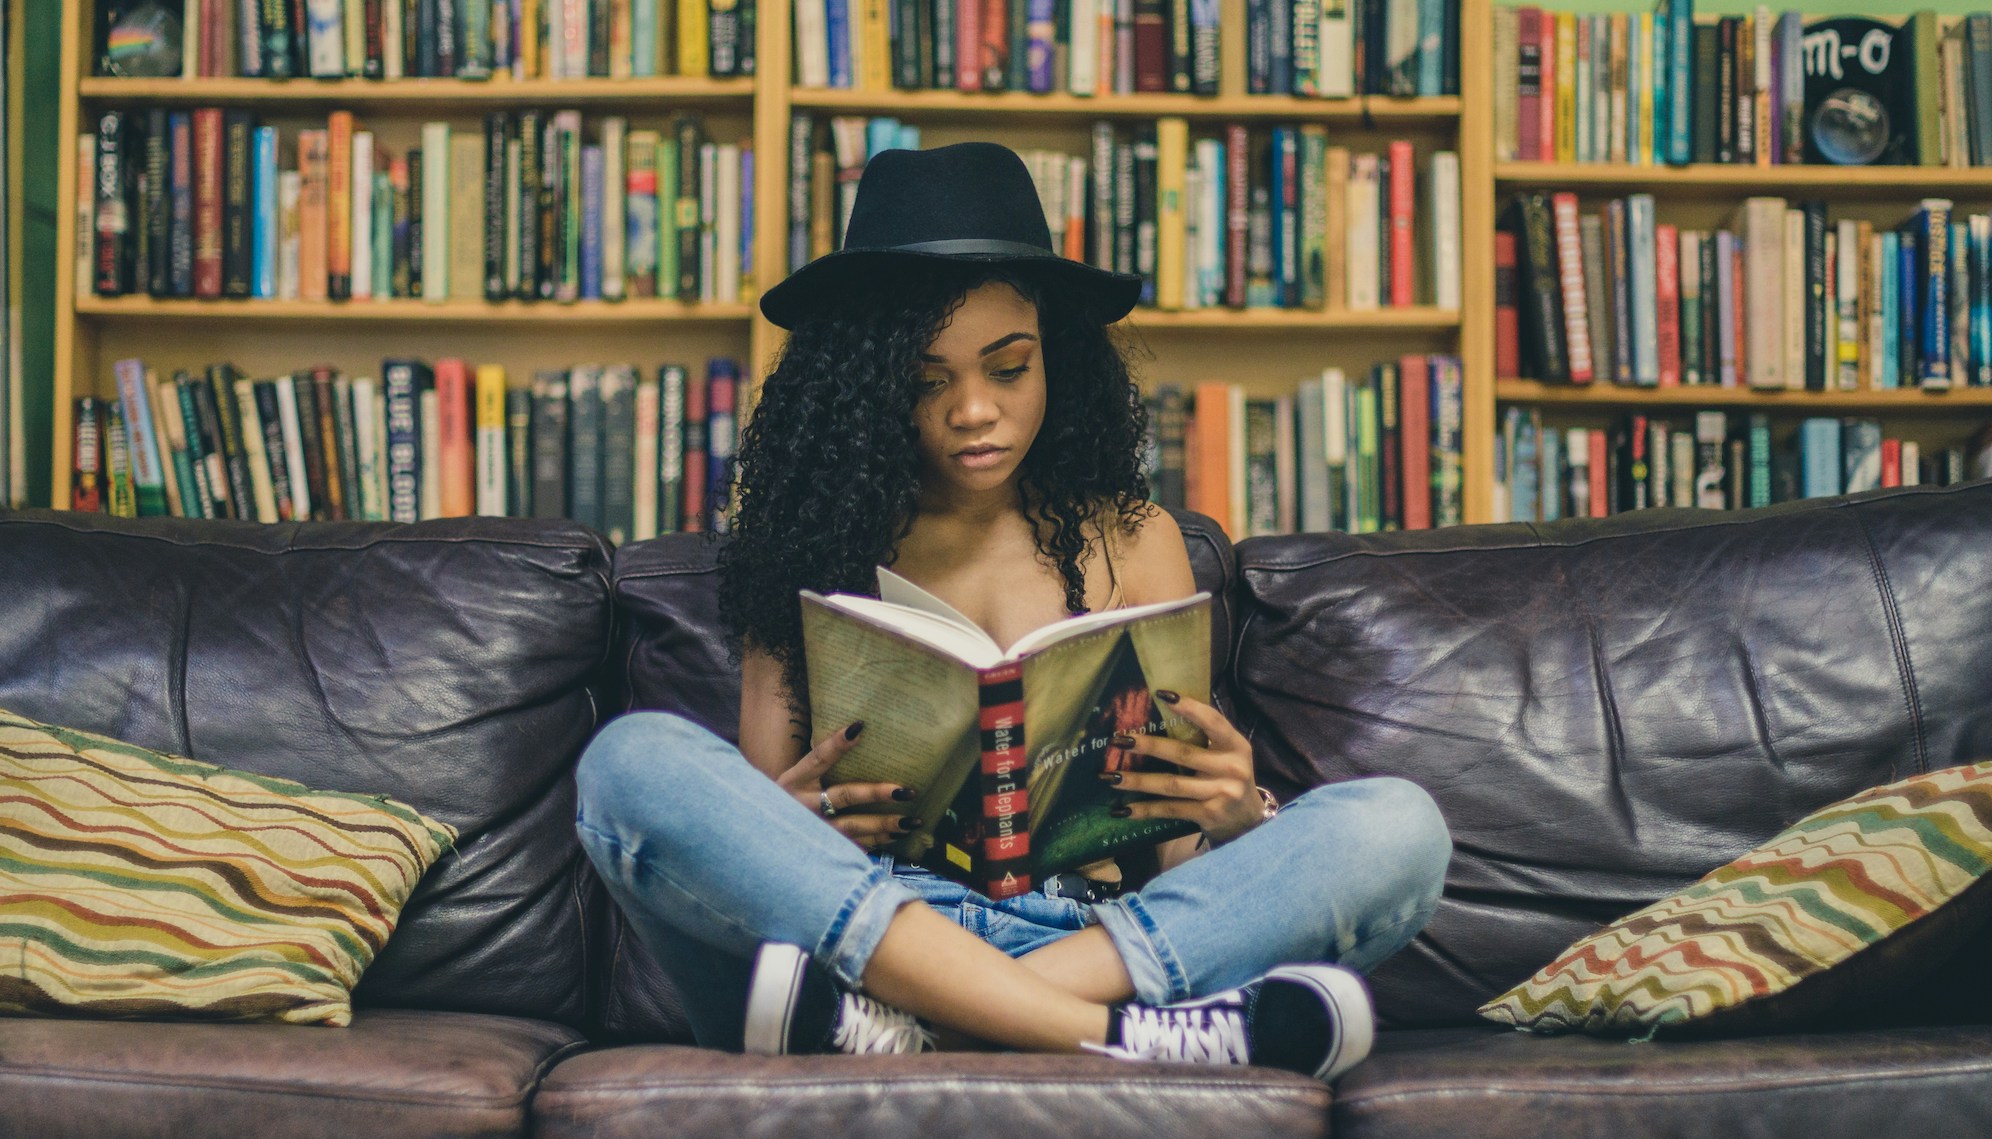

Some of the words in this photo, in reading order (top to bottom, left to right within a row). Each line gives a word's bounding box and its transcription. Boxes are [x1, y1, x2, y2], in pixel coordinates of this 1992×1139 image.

[388, 365, 413, 433] BLUE
[994, 715, 1013, 756] Water
[1043, 744, 1086, 770] Water
[1091, 737, 1109, 750] for
[1113, 715, 1193, 738] lephant
[996, 759, 1015, 779] for
[994, 782, 1017, 850] Elephants
[1102, 832, 1138, 847] SARA
